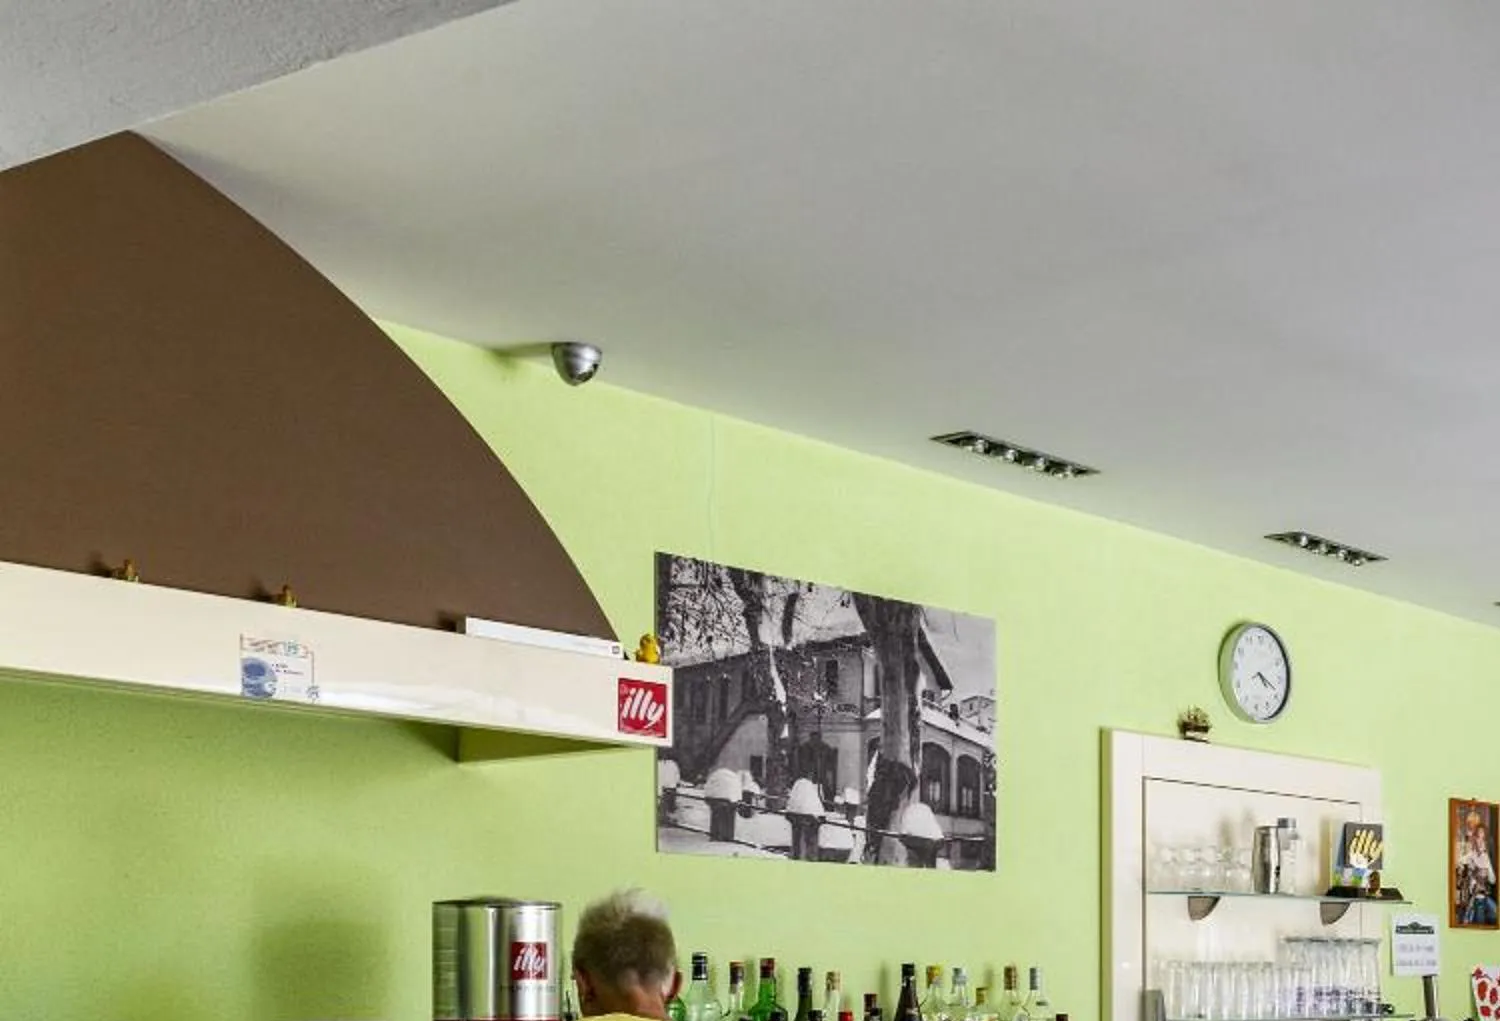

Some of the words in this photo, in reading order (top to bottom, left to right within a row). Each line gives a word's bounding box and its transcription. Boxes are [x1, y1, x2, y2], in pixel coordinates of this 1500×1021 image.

[622, 687, 665, 729] illy
[1350, 829, 1384, 866] illy
[513, 946, 545, 977] illy
